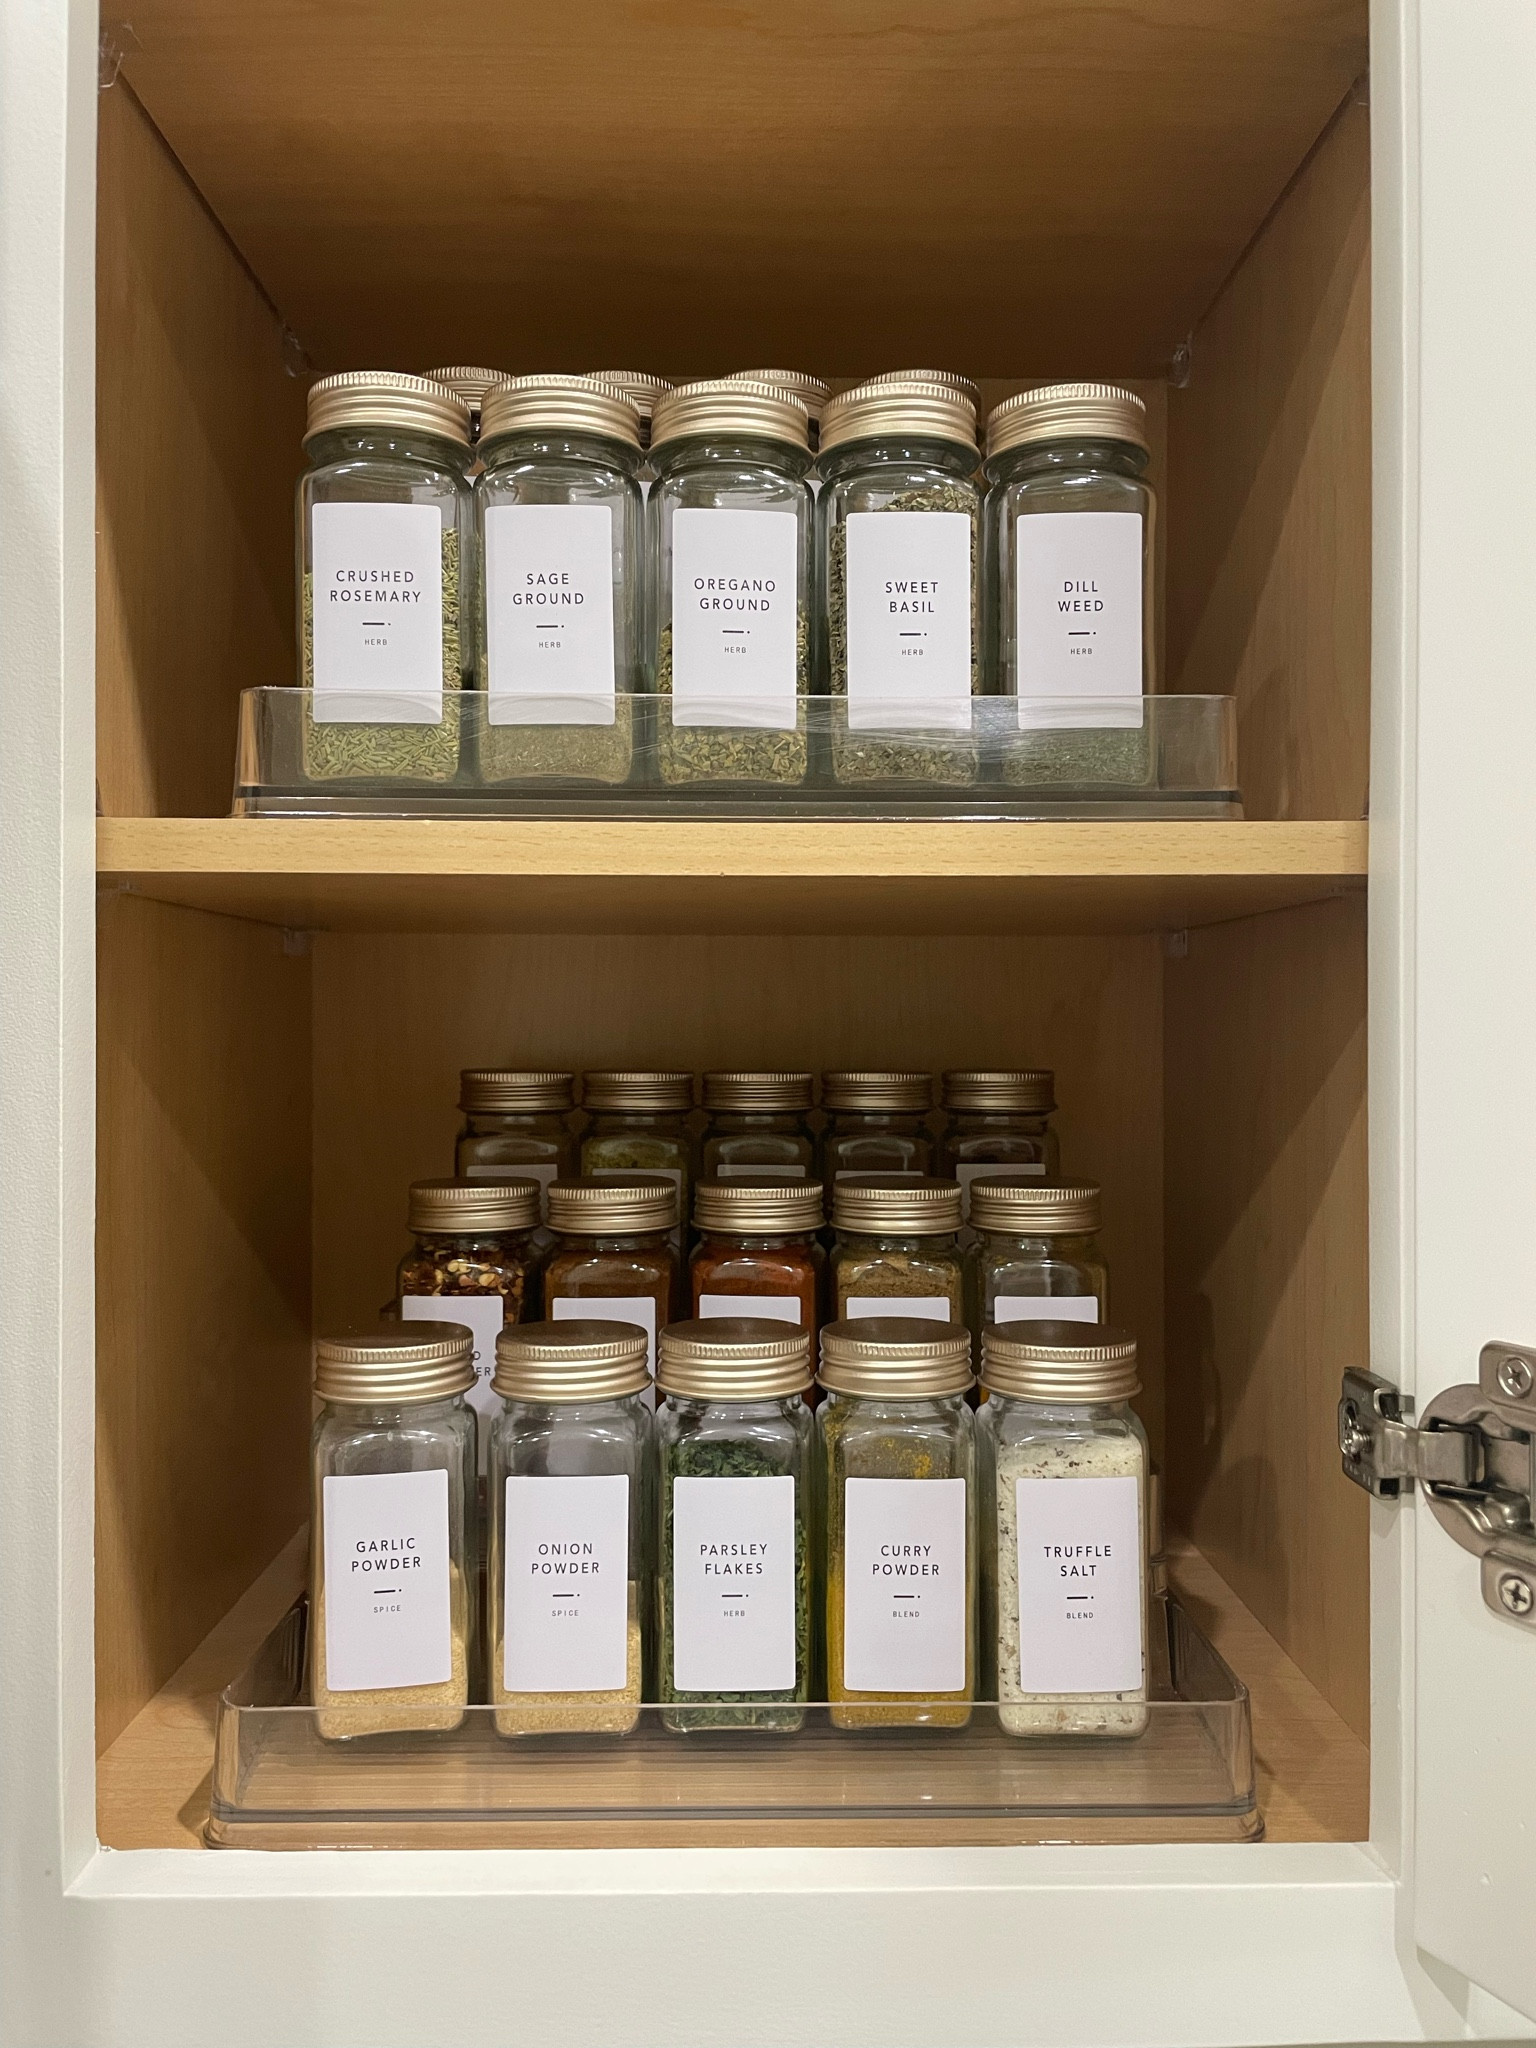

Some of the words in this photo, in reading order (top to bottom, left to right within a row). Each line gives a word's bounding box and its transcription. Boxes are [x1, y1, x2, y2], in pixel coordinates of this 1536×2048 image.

[336, 570, 413, 582] CRUSHED
[527, 573, 569, 585] SAGE
[694, 578, 775, 592] OREGANO
[886, 582, 938, 593] SWEET
[1064, 581, 1098, 592] DILL
[330, 590, 420, 602] ROSEMARY
[513, 593, 583, 605] GROUND
[700, 598, 769, 611] GROUND
[890, 601, 934, 612] BASIL
[1058, 600, 1103, 612] WEED
[364, 638, 388, 646] HERB
[538, 641, 561, 649] HERB
[724, 646, 747, 654] HERB
[901, 648, 924, 656] HERB
[1070, 647, 1093, 655] HERB
[356, 1538, 415, 1552] GARLIC
[539, 1543, 592, 1555] ONION
[701, 1544, 767, 1555] PARSLEY
[881, 1545, 931, 1556] CURRY
[1044, 1545, 1111, 1557] TRUFFLE
[352, 1557, 420, 1572] POWDER
[532, 1562, 599, 1574] POWDER
[705, 1563, 762, 1574] FLAKES
[873, 1564, 939, 1575] POWDER
[1061, 1565, 1096, 1577] SALT
[373, 1604, 401, 1614] SPICE
[551, 1609, 579, 1617] SPICE
[723, 1610, 745, 1618] HERB
[892, 1610, 920, 1618] BLEND
[1066, 1611, 1094, 1620] BLEND
